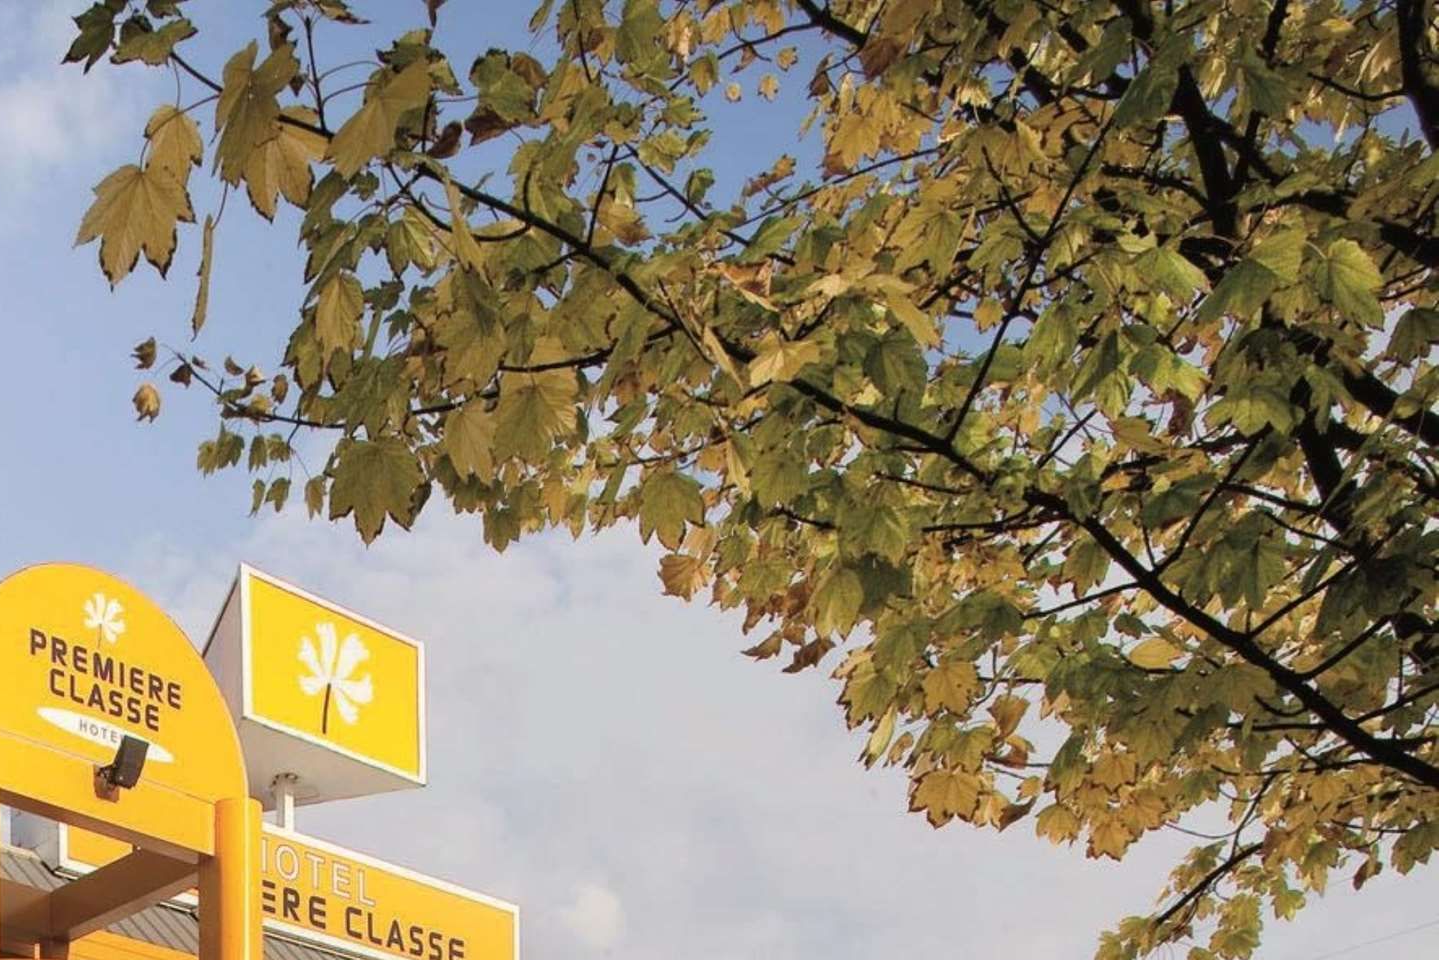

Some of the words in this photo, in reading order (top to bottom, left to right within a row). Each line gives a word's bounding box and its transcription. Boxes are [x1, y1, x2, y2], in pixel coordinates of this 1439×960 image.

[30, 628, 181, 710] PREMIERE
[49, 668, 160, 732] CLASSE
[79, 717, 124, 744] HOTE
